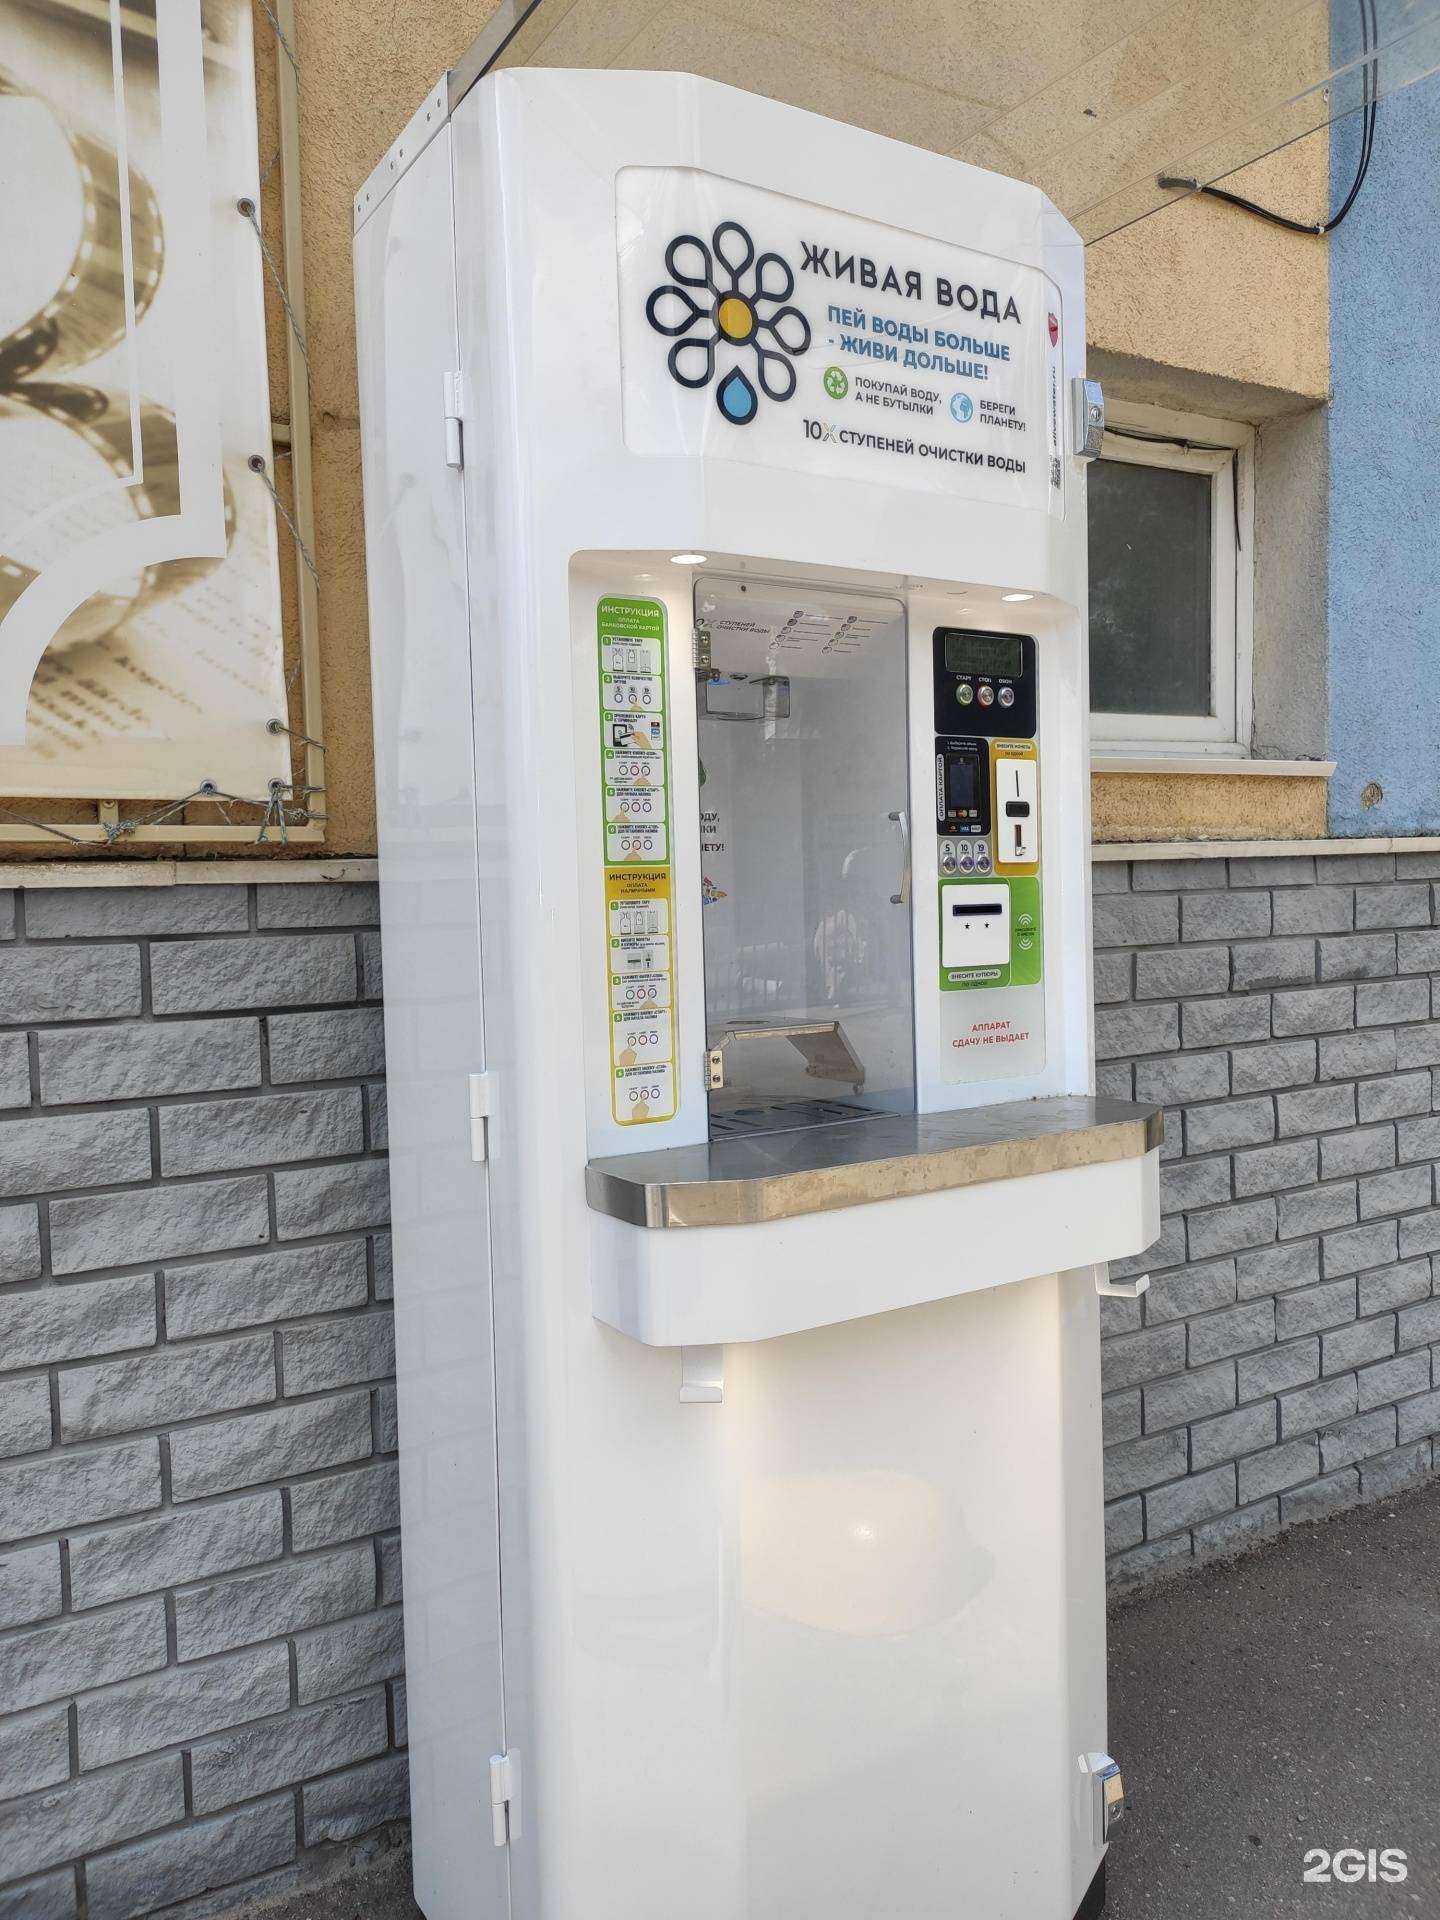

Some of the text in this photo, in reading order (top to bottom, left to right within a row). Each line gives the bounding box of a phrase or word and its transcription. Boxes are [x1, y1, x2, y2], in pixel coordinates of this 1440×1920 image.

[800, 240, 1022, 324] ЖИВАЯ ВОДА
[827, 304, 1011, 361] ПЕЙ ВОДЫ БОЛЬШЕ
[840, 334, 898, 362] ЖИВИ
[903, 349, 989, 380] ДОЛЬШЕ!
[854, 376, 942, 404] ПОКУПАЙ ВОДУ,
[855, 392, 934, 416] А НЕ БУТЫЛКИ
[979, 399, 1016, 416] БЕРЕГИ
[979, 414, 1026, 431] ПЛАНЕТУ!
[838, 430, 914, 455] СТУПЕНЕЙ
[918, 443, 984, 466] ОЧИСТКИ
[987, 454, 1026, 474] ВОДЫ
[601, 605, 660, 617] ИНСТРУКЦИЯ
[945, 843, 985, 852] 5 10 19
[608, 872, 667, 882] ИНСТРУКЦИЯ
[975, 970, 998, 979] КУПЮРЫ
[971, 1021, 1011, 1033] АППАРАТ
[952, 1032, 1030, 1049] СДАЧУ НЕ ВЫДАЕТ
